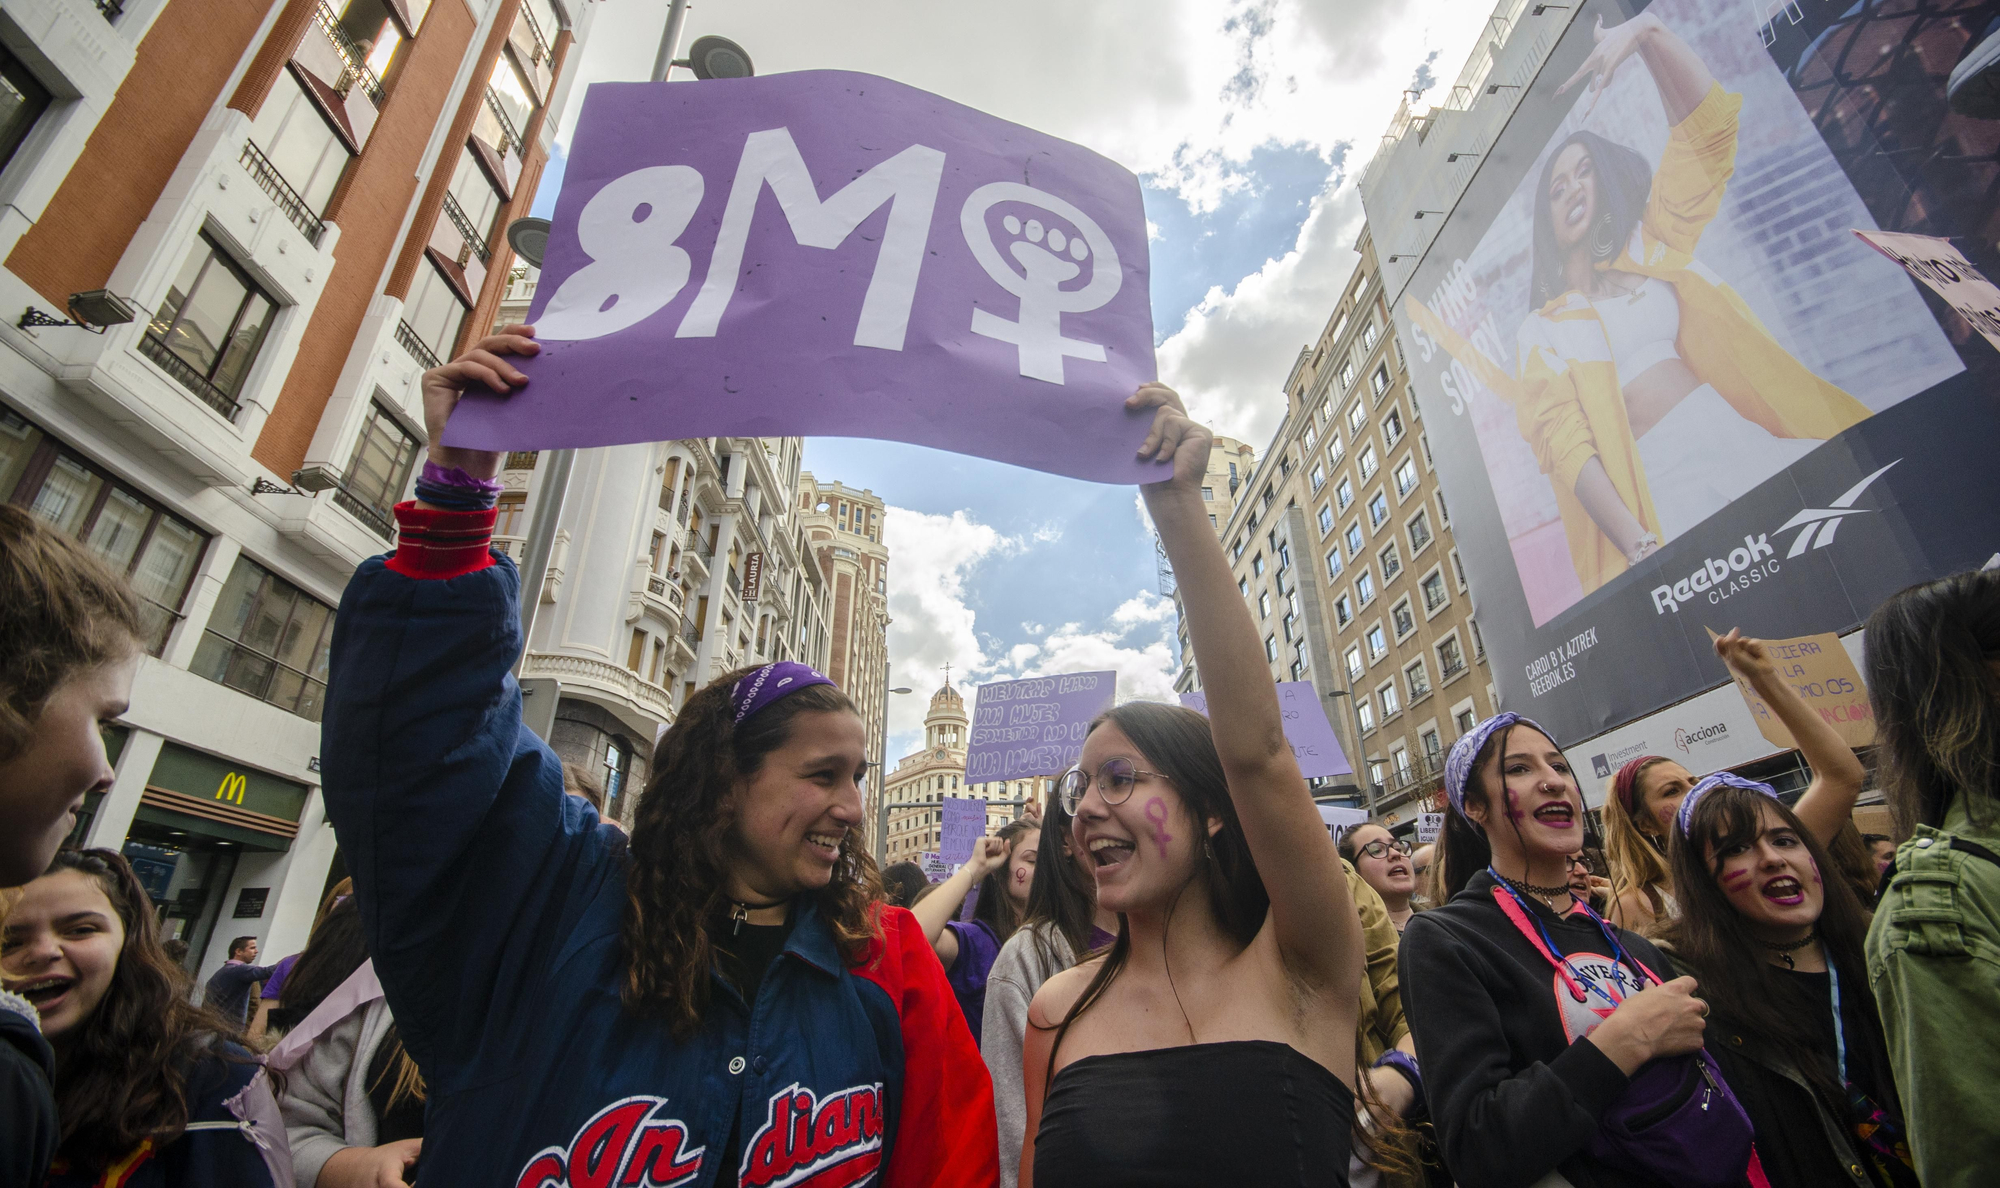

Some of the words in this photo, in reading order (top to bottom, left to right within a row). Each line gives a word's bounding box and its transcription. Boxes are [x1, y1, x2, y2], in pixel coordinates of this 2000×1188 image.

[530, 126, 947, 352] 8M
[1411, 258, 1477, 363] SAYING
[1440, 311, 1508, 416] SORRY
[748, 554, 760, 589] LAURIA
[1650, 532, 1774, 615] Reebok
[1708, 559, 1781, 605] CLASSIC
[1525, 654, 1551, 681] CARDI
[1549, 650, 1559, 667] B
[1556, 645, 1567, 663] X
[1566, 626, 1599, 660] AZTREK
[980, 679, 1056, 704] MIENTRAS
[1058, 676, 1098, 694] HAYA
[1530, 661, 1576, 698] REEBOK.ES
[1043, 724, 1068, 742] NO
[1608, 740, 1648, 762] Investment
[1685, 722, 1728, 745] acciona
